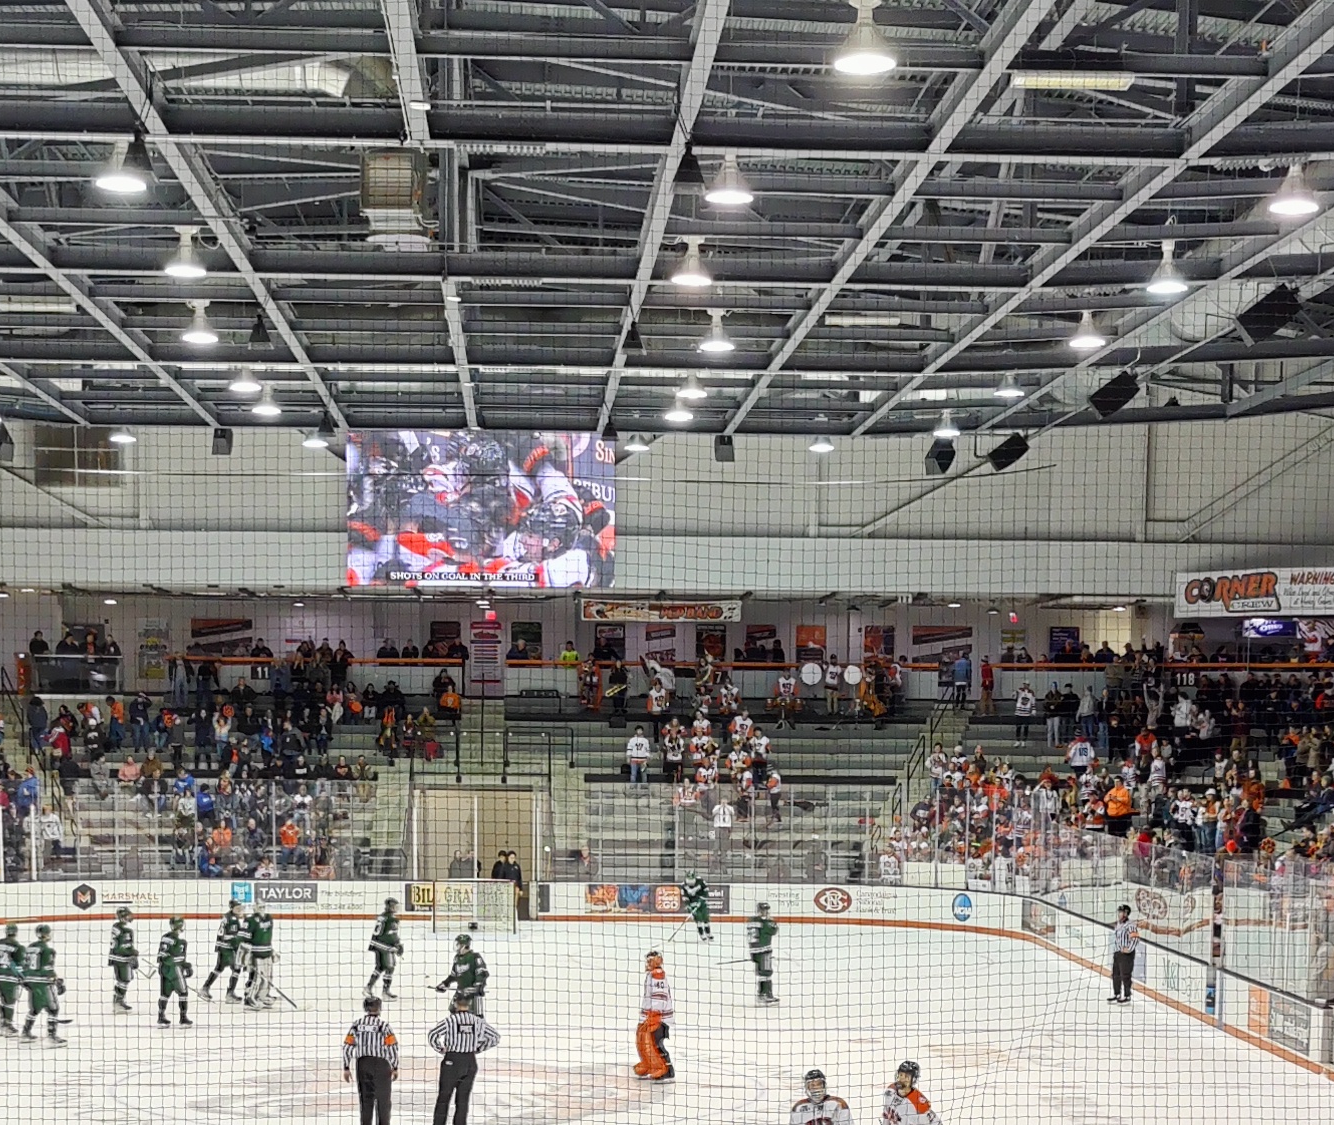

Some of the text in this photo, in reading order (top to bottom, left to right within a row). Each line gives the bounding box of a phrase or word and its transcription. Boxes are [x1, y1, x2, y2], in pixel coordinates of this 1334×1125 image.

[390, 571, 535, 582] SHOTS ON GOAL IN THE THIRD
[1185, 572, 1277, 605] CORNER
[1231, 600, 1274, 609] CREW
[1175, 673, 1195, 686] 118
[102, 892, 159, 900] MARSHALL
[259, 887, 312, 899] TAYLOR
